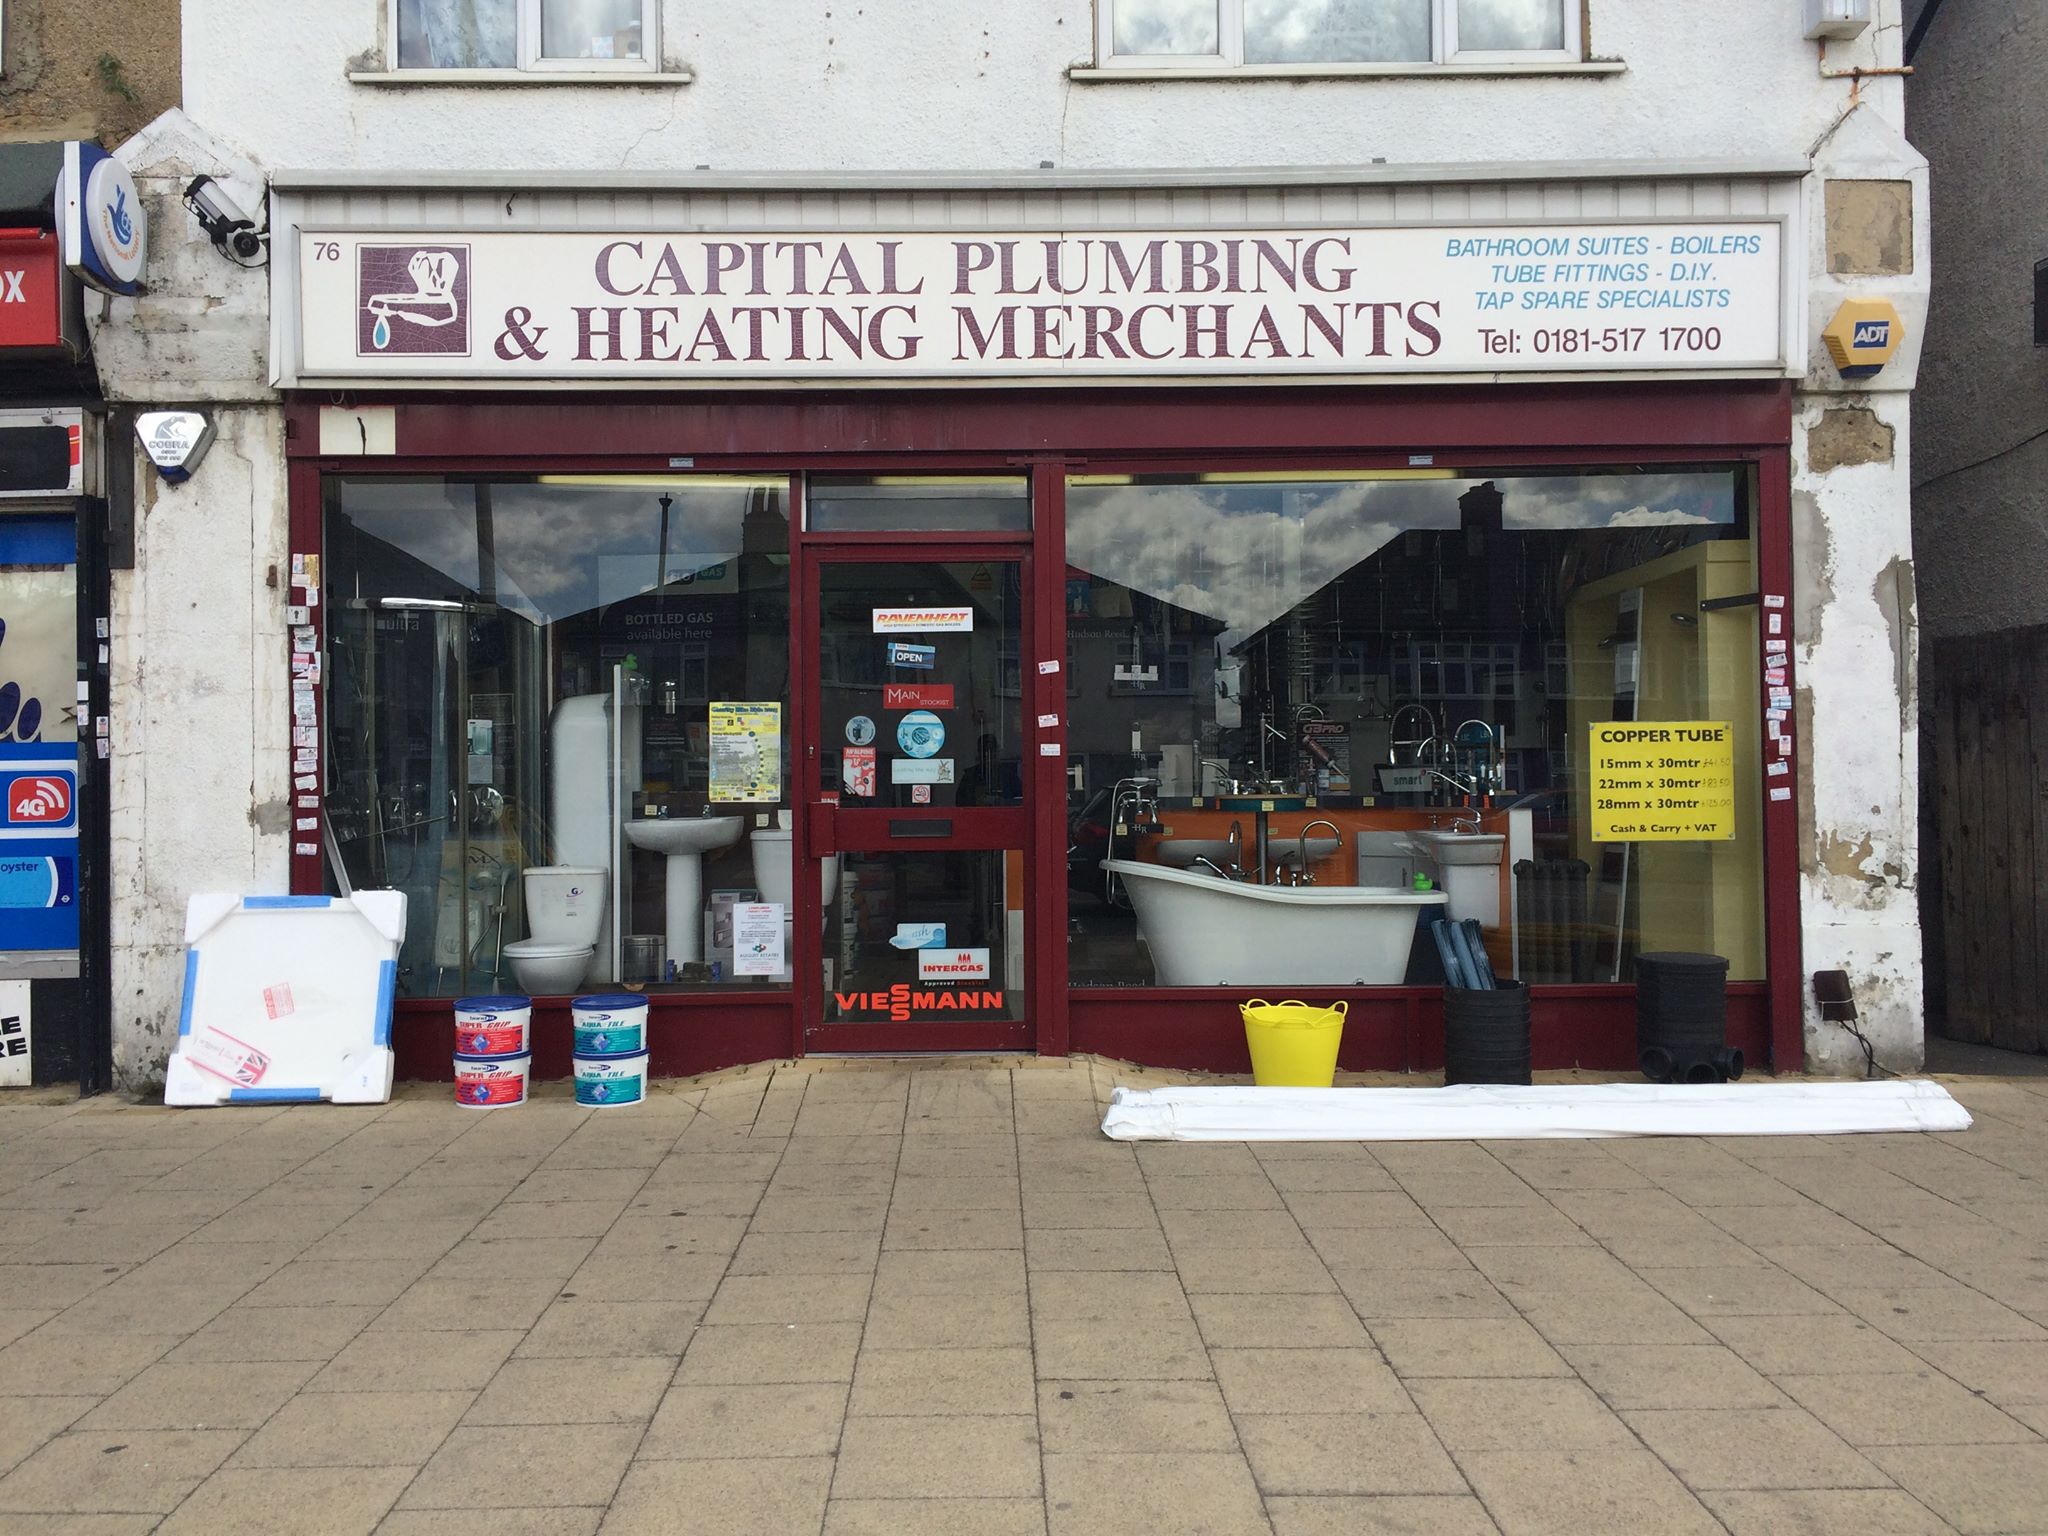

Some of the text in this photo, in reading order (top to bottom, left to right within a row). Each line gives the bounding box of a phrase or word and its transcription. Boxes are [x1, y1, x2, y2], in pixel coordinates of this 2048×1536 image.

[314, 242, 341, 261] 76
[1446, 238, 1569, 257] BATHROOM
[1577, 237, 1649, 256] SUITES
[1670, 235, 1761, 255] BOILERS
[595, 237, 1358, 296] CAPITAL PLUMBING
[1491, 265, 1546, 283] TUBE
[1553, 263, 1648, 282] FITTINGS
[1670, 263, 1717, 282] D.I.Y.
[0, 270, 26, 303] X
[1475, 289, 1731, 310] TAP SPARE SPECIALISTS
[493, 300, 1442, 361] & HEATING MERCHANTS
[1854, 325, 1890, 343] ADT
[1478, 326, 1721, 354] Tel: 0181-517 1700
[148, 440, 189, 449] COBRA
[625, 612, 714, 625] BOTTLED GAS
[876, 612, 968, 624] RAVENHEAT
[627, 626, 713, 640] available here
[1066, 628, 1102, 639] Hudson
[896, 652, 923, 663] OPEN
[1600, 729, 1724, 742] COPPER TUBE
[1600, 758, 1641, 769] 15mm
[1658, 758, 1700, 769] 30mtr
[1393, 775, 1422, 786] smart
[1599, 778, 1641, 789] 22mm
[1658, 778, 1701, 789] 30mtr
[16, 798, 45, 817] 4G
[1597, 799, 1640, 809] 28mm
[1657, 798, 1700, 809] 30mtr
[1610, 824, 1636, 833] Cash
[1651, 824, 1681, 834] Carry
[1694, 823, 1717, 832] VAT
[0, 861, 39, 874] oyster
[923, 964, 984, 972] INTERGAS
[834, 983, 1003, 1021] VIESSMANN
